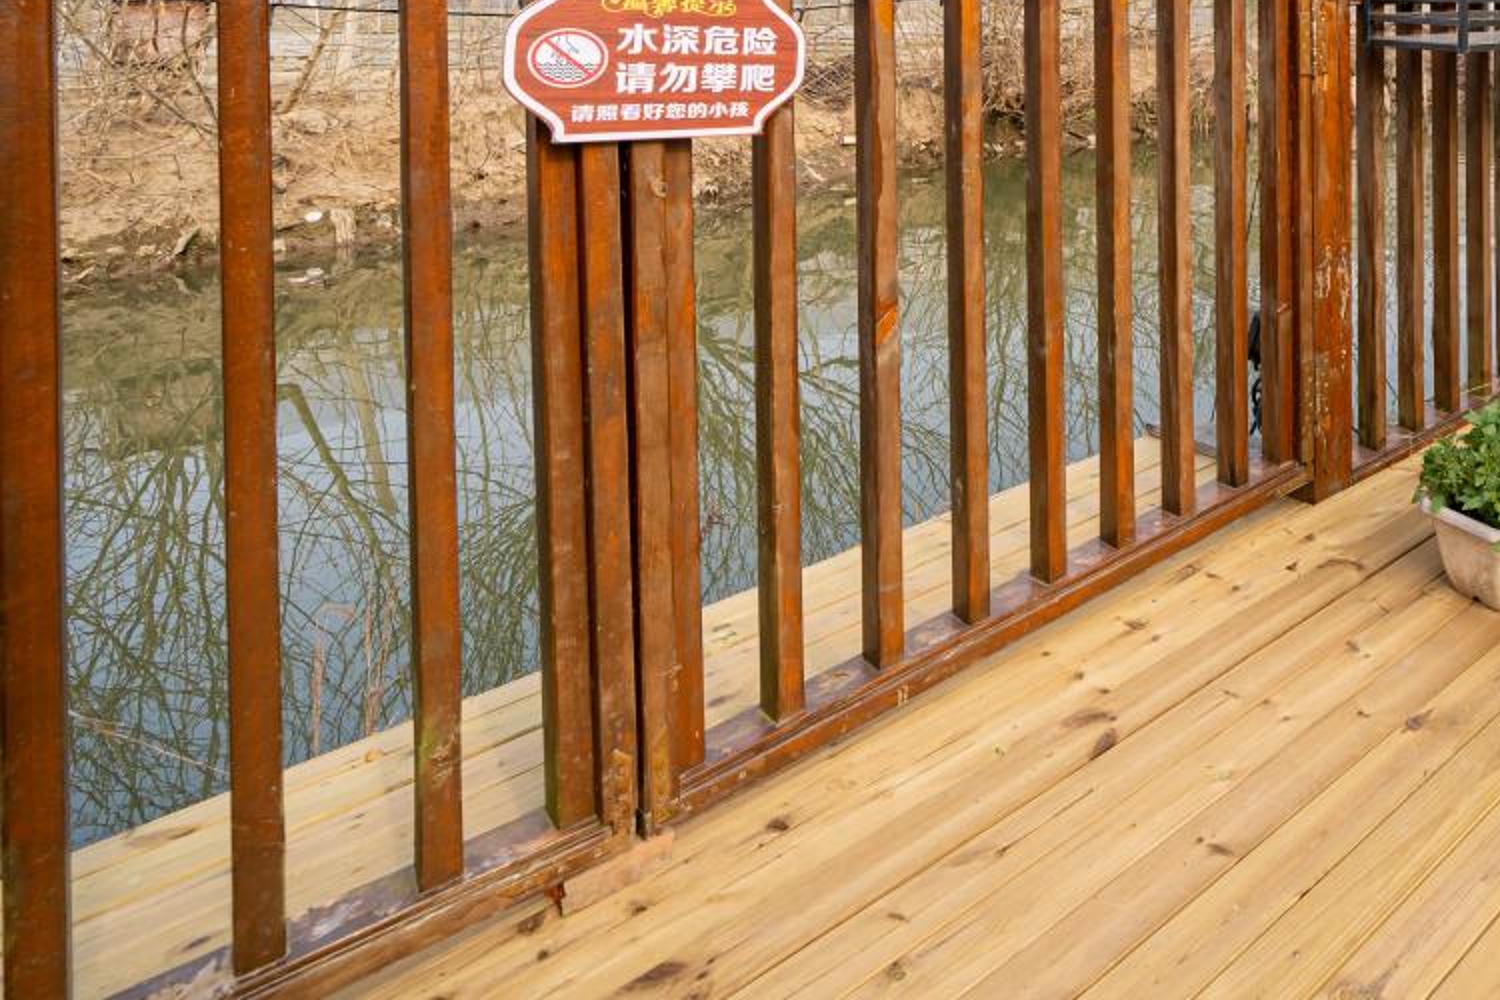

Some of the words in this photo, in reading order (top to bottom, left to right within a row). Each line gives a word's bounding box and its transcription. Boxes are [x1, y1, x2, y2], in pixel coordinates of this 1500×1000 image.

[617, 23, 777, 55] 水深危险
[615, 63, 775, 94] 请勿攀爬
[571, 101, 750, 123] 请照看好您的小孩
